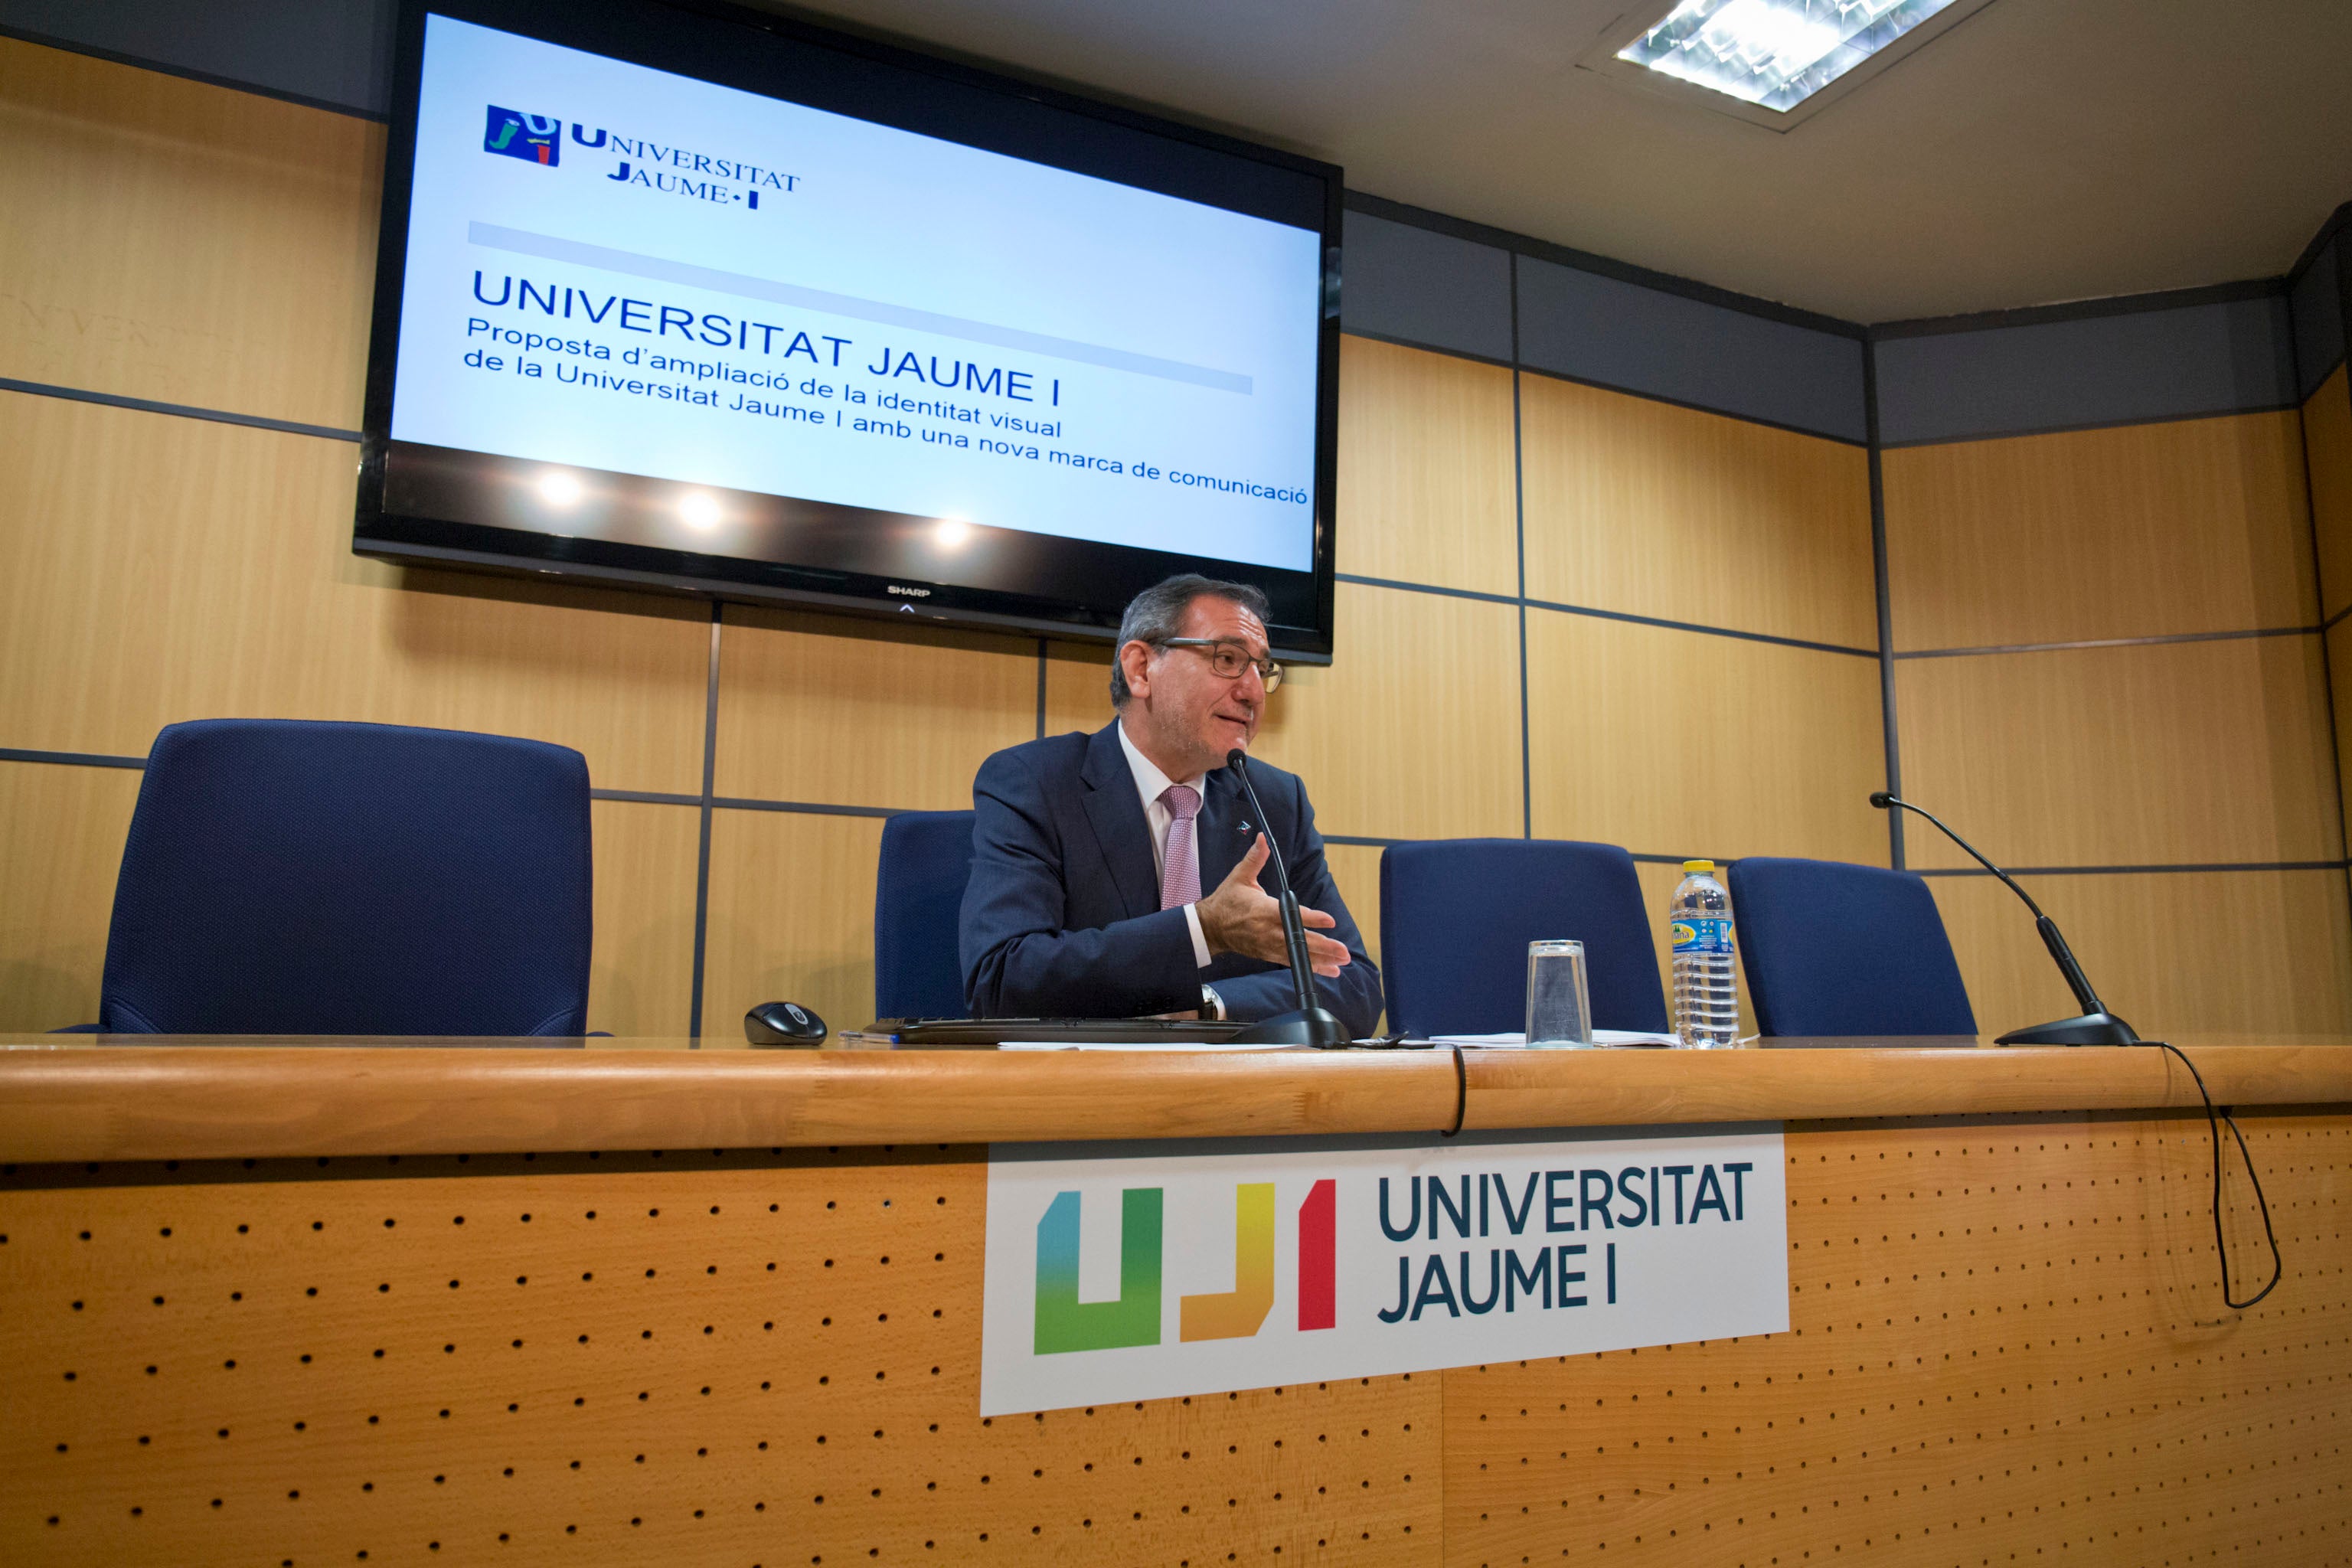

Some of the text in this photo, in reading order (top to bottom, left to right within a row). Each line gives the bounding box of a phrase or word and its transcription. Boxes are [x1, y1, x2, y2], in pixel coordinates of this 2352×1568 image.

[570, 122, 802, 194] UNIVERSITAT
[467, 317, 1061, 439] Proposta d'ampliació de la identitat visual
[473, 270, 1060, 407] UNIVERSITAT JAUME I
[463, 348, 505, 371] de
[516, 355, 542, 378] la
[556, 362, 719, 408] Universitat
[729, 393, 825, 424] Jaume
[852, 417, 912, 439] amb
[921, 428, 969, 449] una
[979, 438, 1039, 460] nova
[1049, 449, 1123, 475] marca
[1132, 461, 1161, 481] de
[1168, 471, 1308, 505] comunicació
[887, 586, 931, 597] SHARP
[1377, 1161, 1754, 1243] UNIVERSITAT
[1034, 1178, 1336, 1356] UJI
[1377, 1243, 1616, 1324] JAUME I
